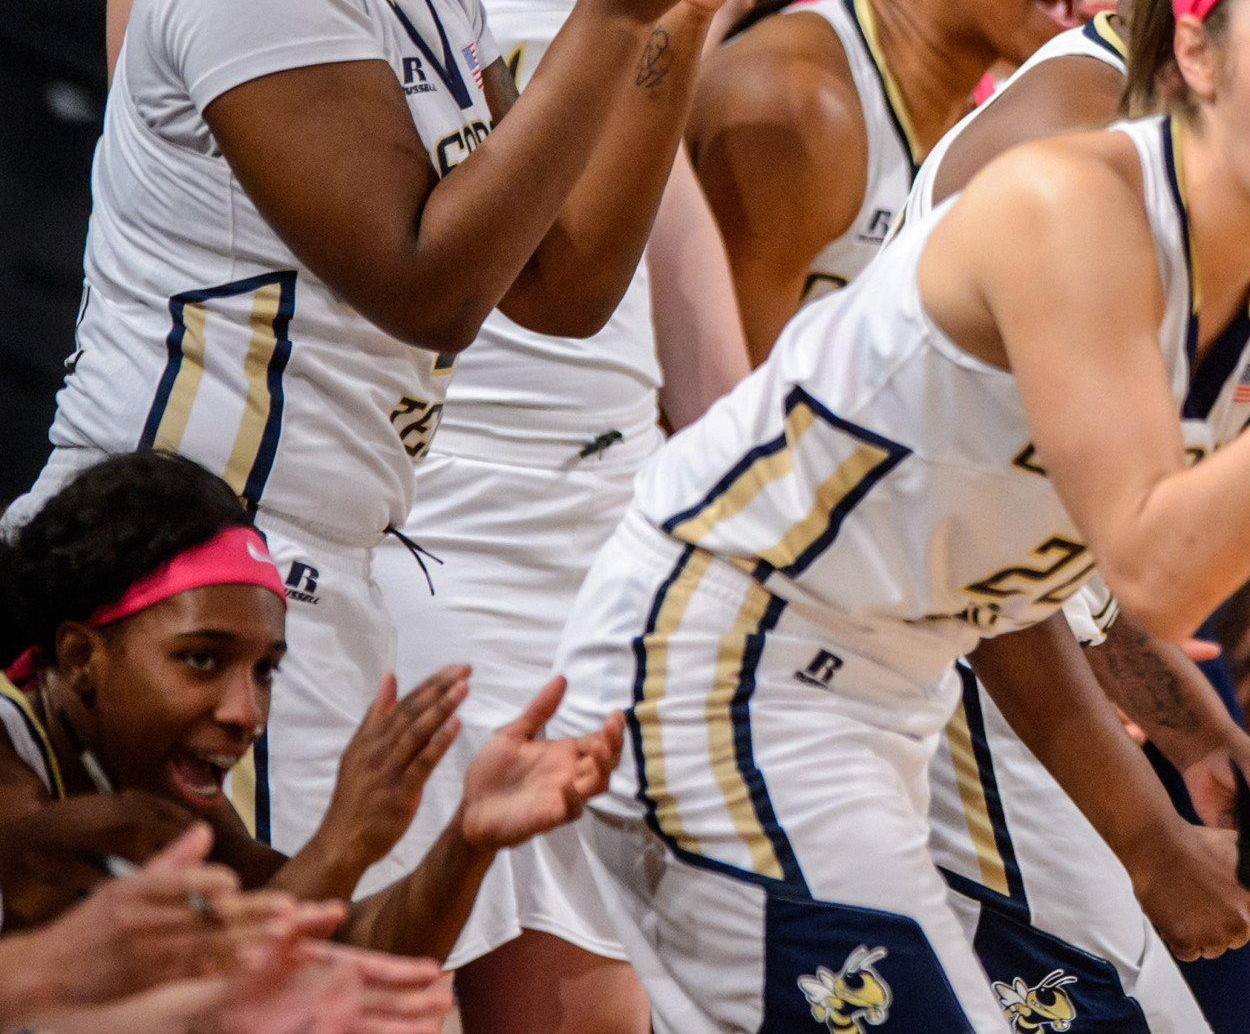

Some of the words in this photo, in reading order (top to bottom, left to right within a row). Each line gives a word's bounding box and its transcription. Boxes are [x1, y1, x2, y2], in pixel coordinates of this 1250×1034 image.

[402, 56, 427, 85] R
[285, 560, 320, 595] R
[805, 648, 844, 685] R
